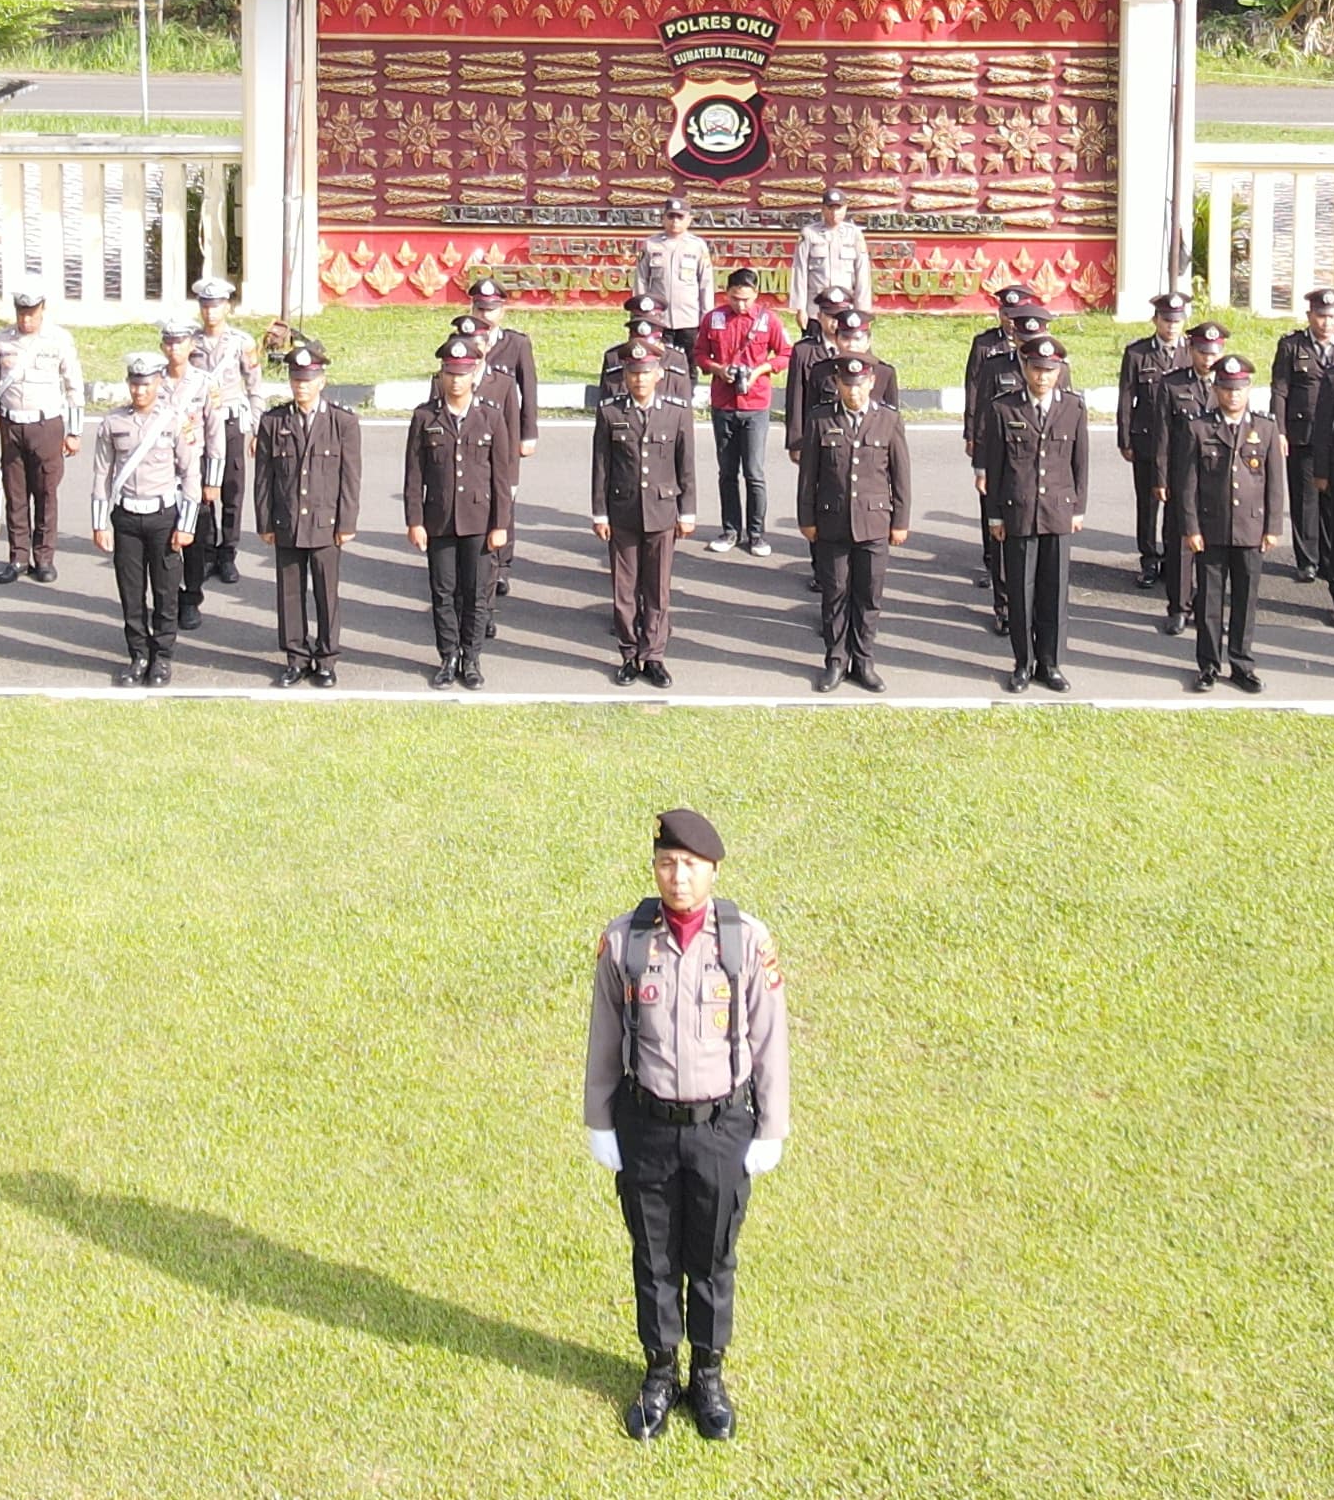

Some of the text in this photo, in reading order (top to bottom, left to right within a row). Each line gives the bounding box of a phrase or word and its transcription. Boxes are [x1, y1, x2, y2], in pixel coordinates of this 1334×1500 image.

[665, 16, 774, 38] POLRES OKU
[674, 47, 765, 66] SUMATERA SELATAN
